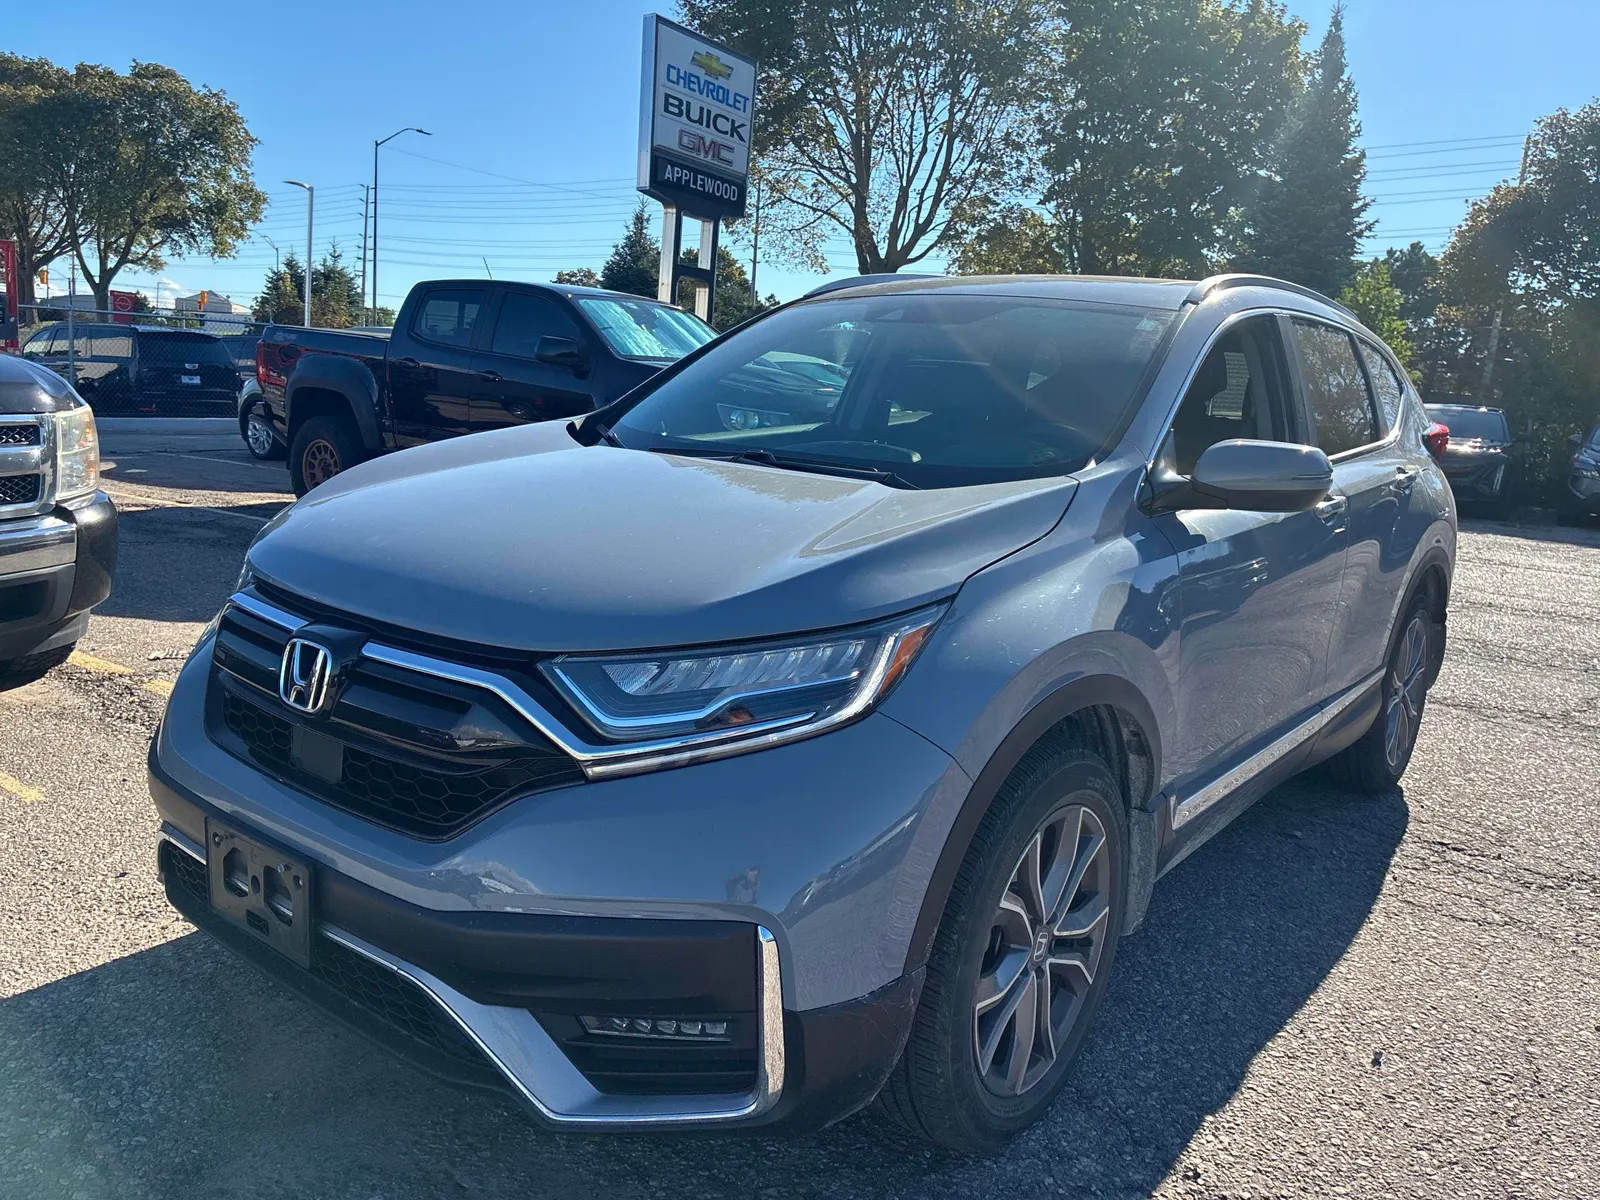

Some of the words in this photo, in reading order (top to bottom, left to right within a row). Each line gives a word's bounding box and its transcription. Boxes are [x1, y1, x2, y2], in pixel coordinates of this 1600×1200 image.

[666, 64, 749, 113] CHEVROLET
[663, 92, 746, 143] BUICK
[678, 129, 734, 167] GMC
[664, 165, 738, 201] APPLEWOOD
